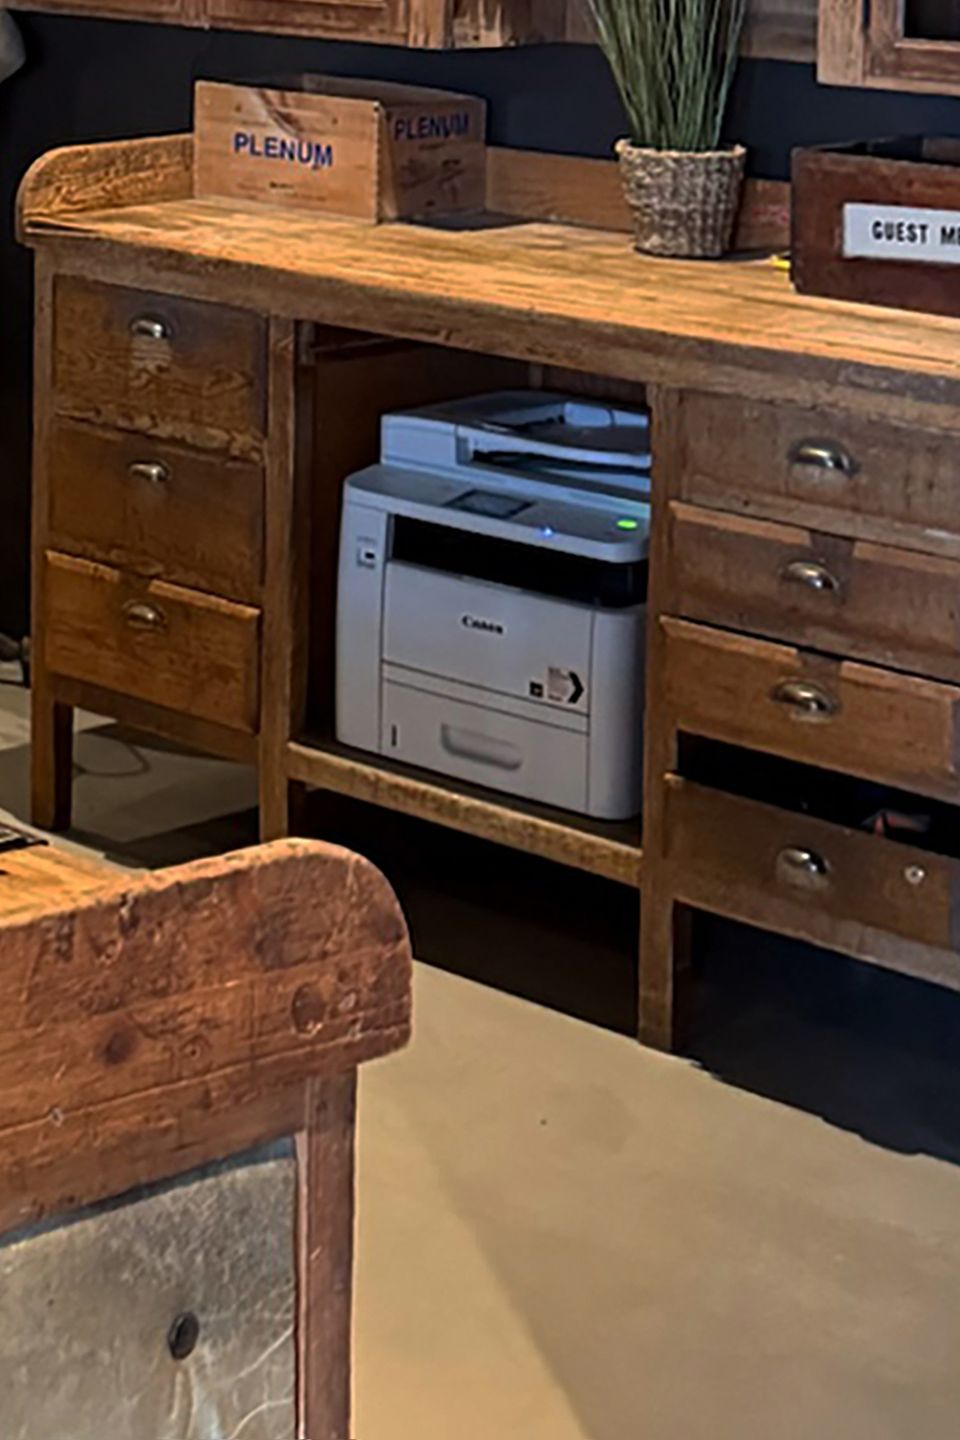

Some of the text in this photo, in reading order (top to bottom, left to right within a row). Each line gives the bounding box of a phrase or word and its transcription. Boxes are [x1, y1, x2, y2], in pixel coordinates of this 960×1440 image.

[394, 113, 469, 140] PLENUM
[234, 132, 333, 168] PLENUM
[872, 220, 928, 244] GUEST
[461, 615, 503, 634] Canon
